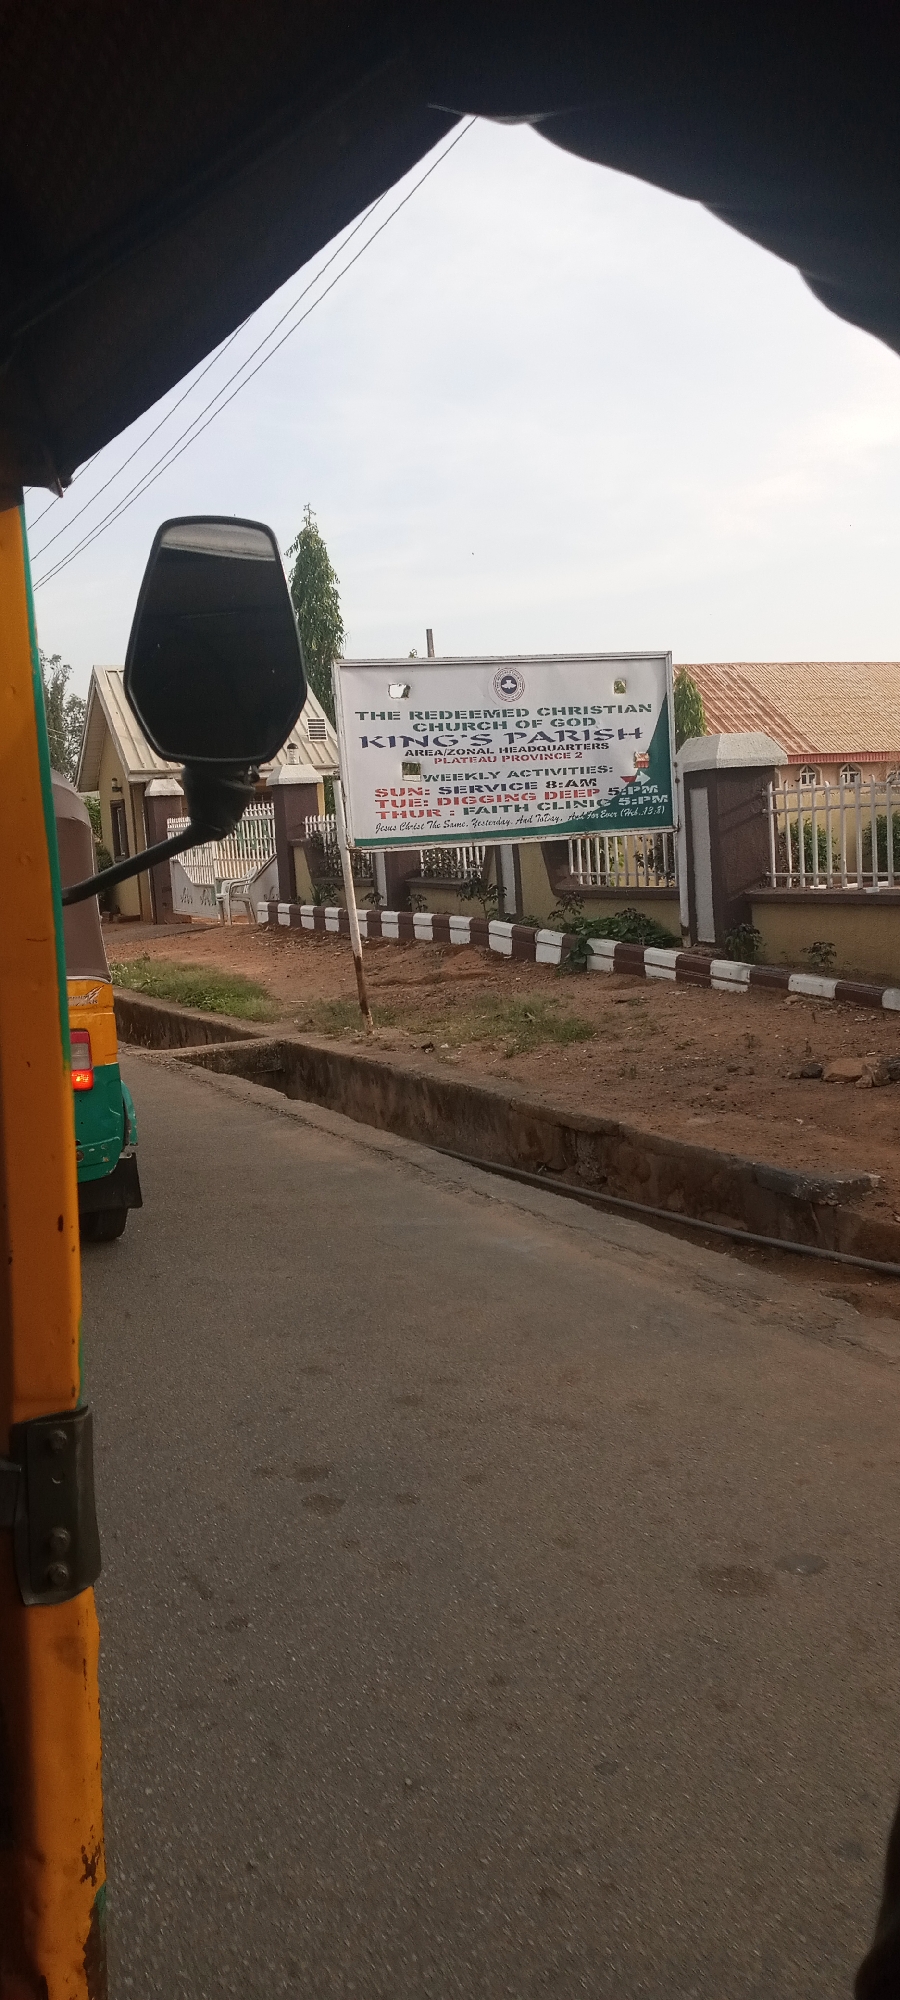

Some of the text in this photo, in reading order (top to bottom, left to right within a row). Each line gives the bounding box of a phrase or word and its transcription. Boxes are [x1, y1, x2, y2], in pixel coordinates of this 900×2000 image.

[354, 703, 652, 721] THE REDEEMED CHRISTIAN
[412, 717, 597, 732] CHURCH OF GOD
[358, 727, 643, 749] KING'S PARISH
[404, 742, 610, 757] AREA/ZONAL HEADQUARTERS
[434, 756, 497, 765] PLATEAU
[501, 752, 571, 763] PROVINCE
[423, 765, 614, 783] WEEKLY ACTIVITIES:
[374, 778, 597, 798] SUN: SERVICE 8:AM
[374, 784, 659, 809] TUE: DIGGING DEEP 5:PM
[375, 809, 442, 820] THUR
[463, 803, 529, 816] FAITH
[537, 798, 611, 811] CLINIC
[618, 794, 669, 806] 5:PM
[375, 822, 397, 834] Jesus
[399, 821, 425, 831] Christ
[426, 820, 441, 829] The
[514, 814, 534, 825] And
[567, 811, 585, 821] And
